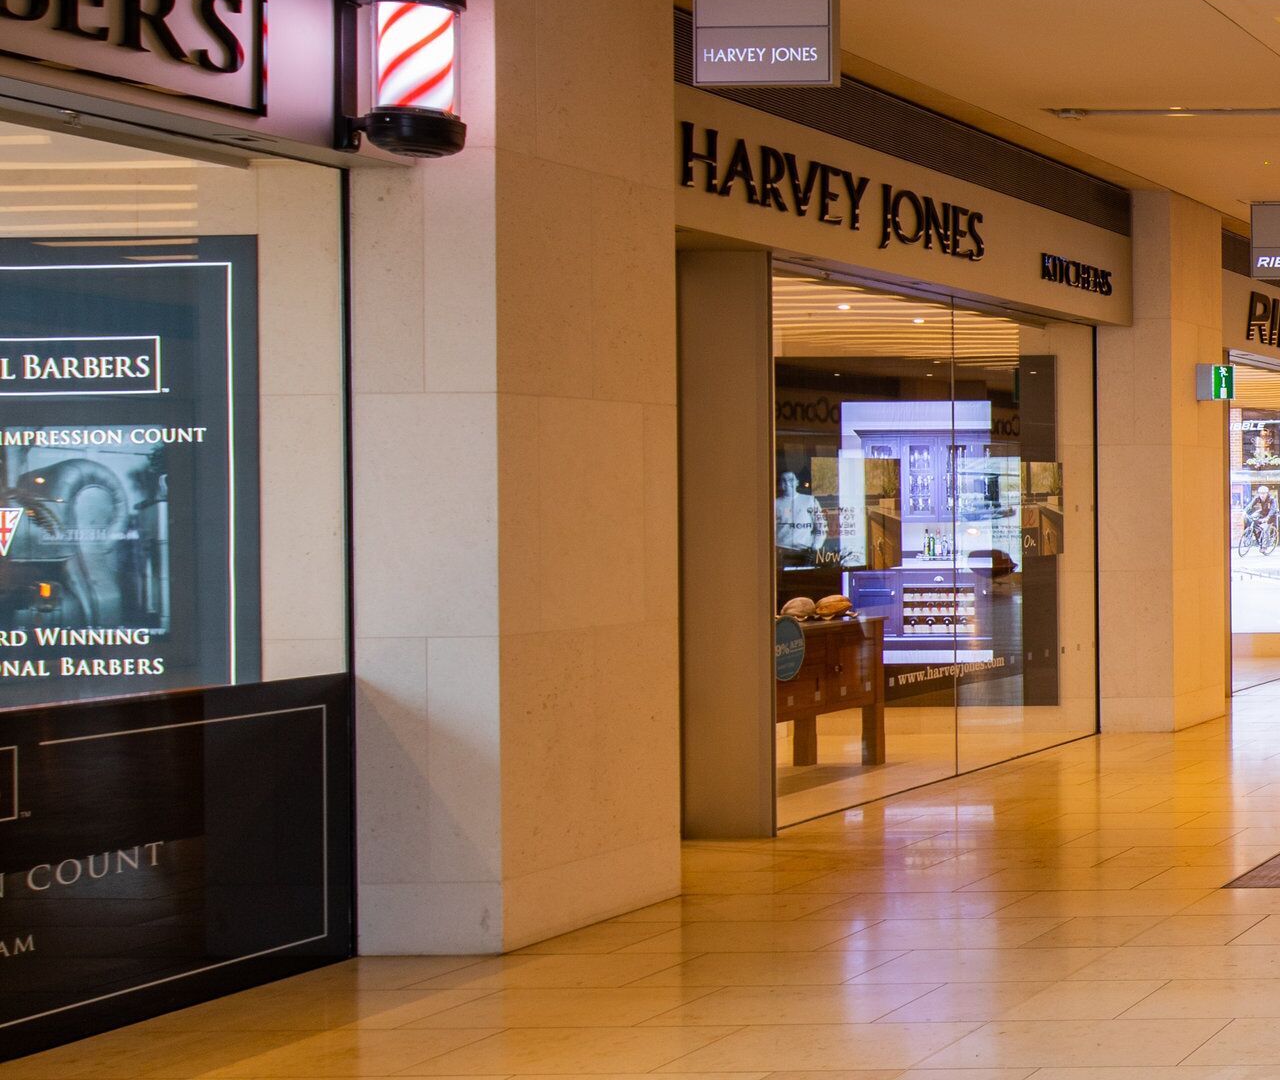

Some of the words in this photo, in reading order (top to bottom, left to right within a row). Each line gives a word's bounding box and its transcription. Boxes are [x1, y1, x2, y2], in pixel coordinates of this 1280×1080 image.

[703, 48, 766, 62] HARVEY
[770, 47, 818, 63] JONES
[681, 121, 870, 230] HARVEY
[878, 183, 985, 262] JONES
[1040, 252, 1113, 296] KITCHENS
[130, 427, 207, 445] COUNT
[1024, 535, 1037, 547] On
[815, 548, 841, 564] Now
[34, 627, 150, 647] WINNING
[60, 657, 165, 676] BARBERS
[897, 654, 1006, 686] www.harveyjones.com
[27, 842, 165, 892] COUNT
